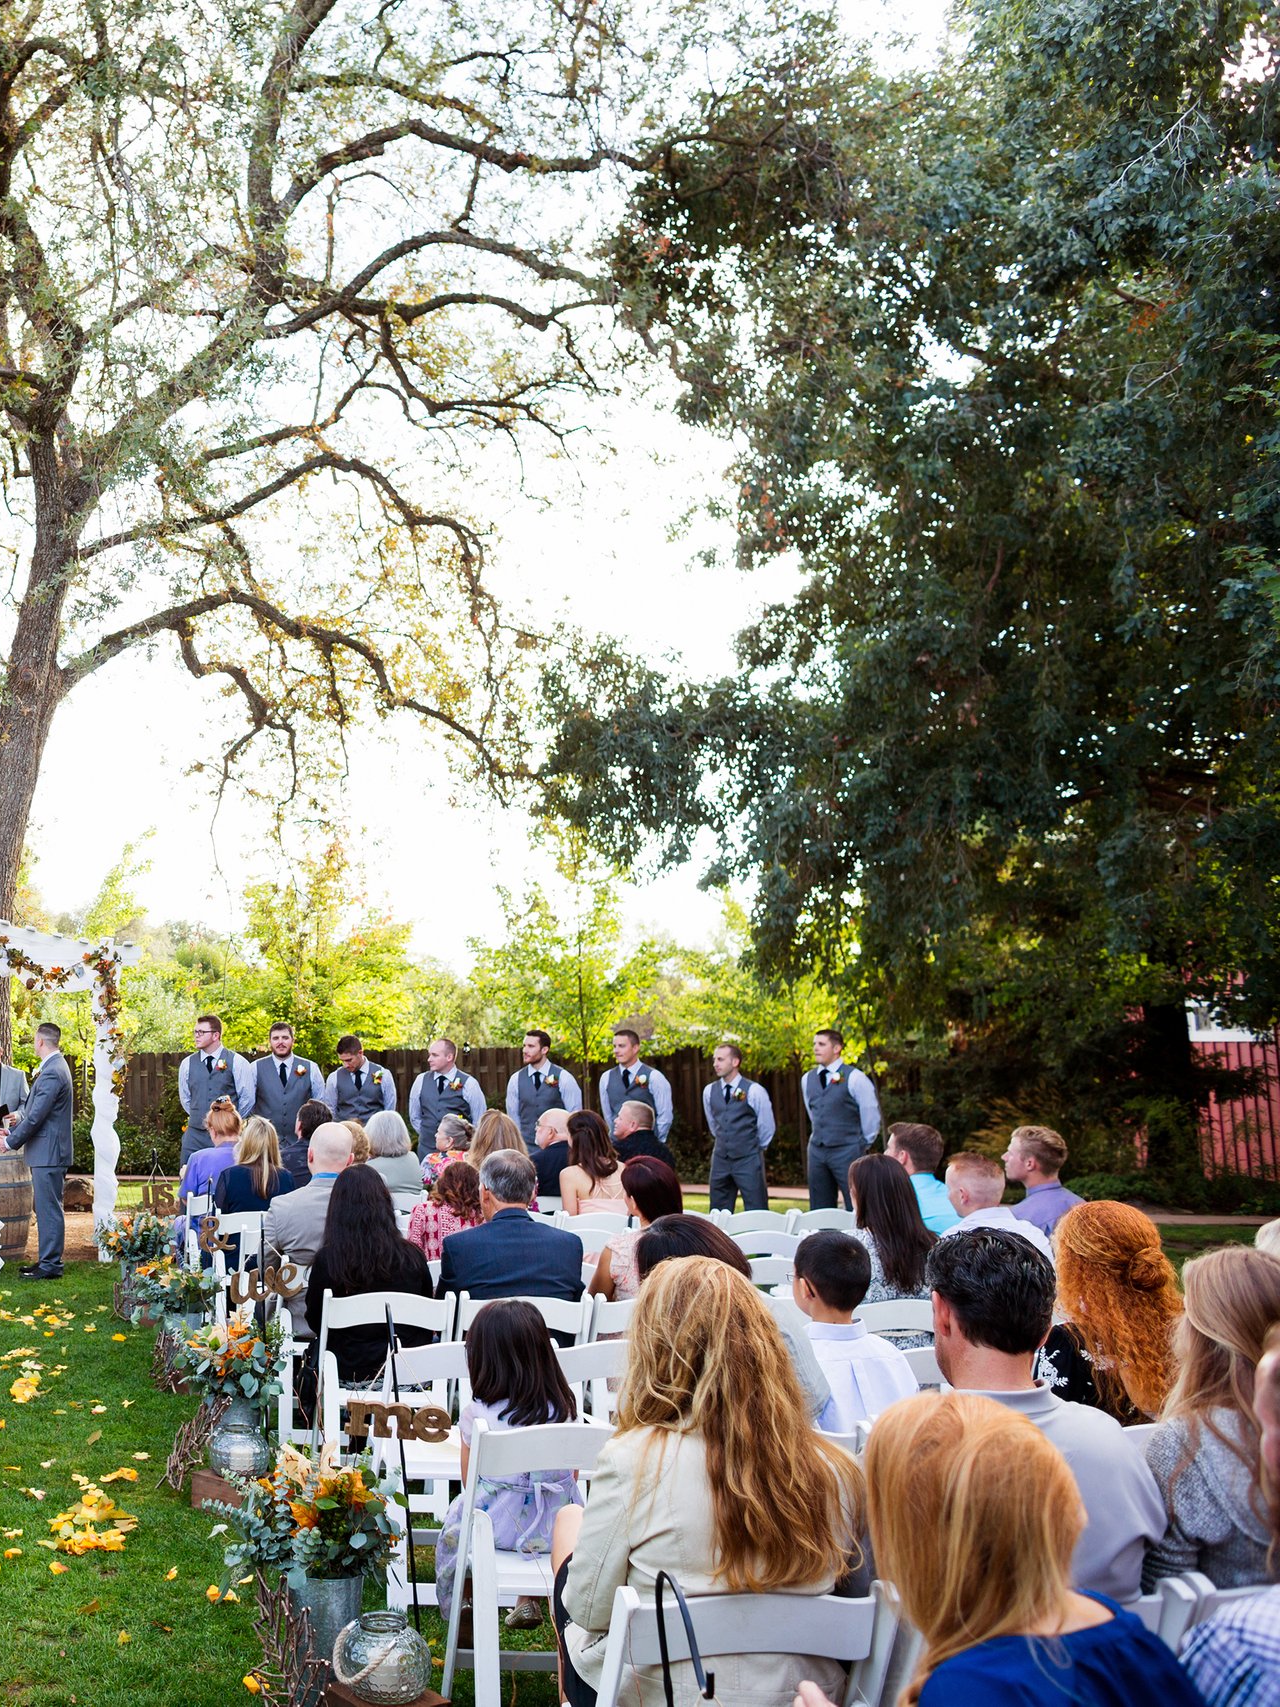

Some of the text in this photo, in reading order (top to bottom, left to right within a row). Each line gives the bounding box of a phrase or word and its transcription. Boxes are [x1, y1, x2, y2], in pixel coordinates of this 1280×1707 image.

[200, 1216, 236, 1252] &
[230, 1263, 303, 1304] we
[344, 1400, 452, 1443] me
